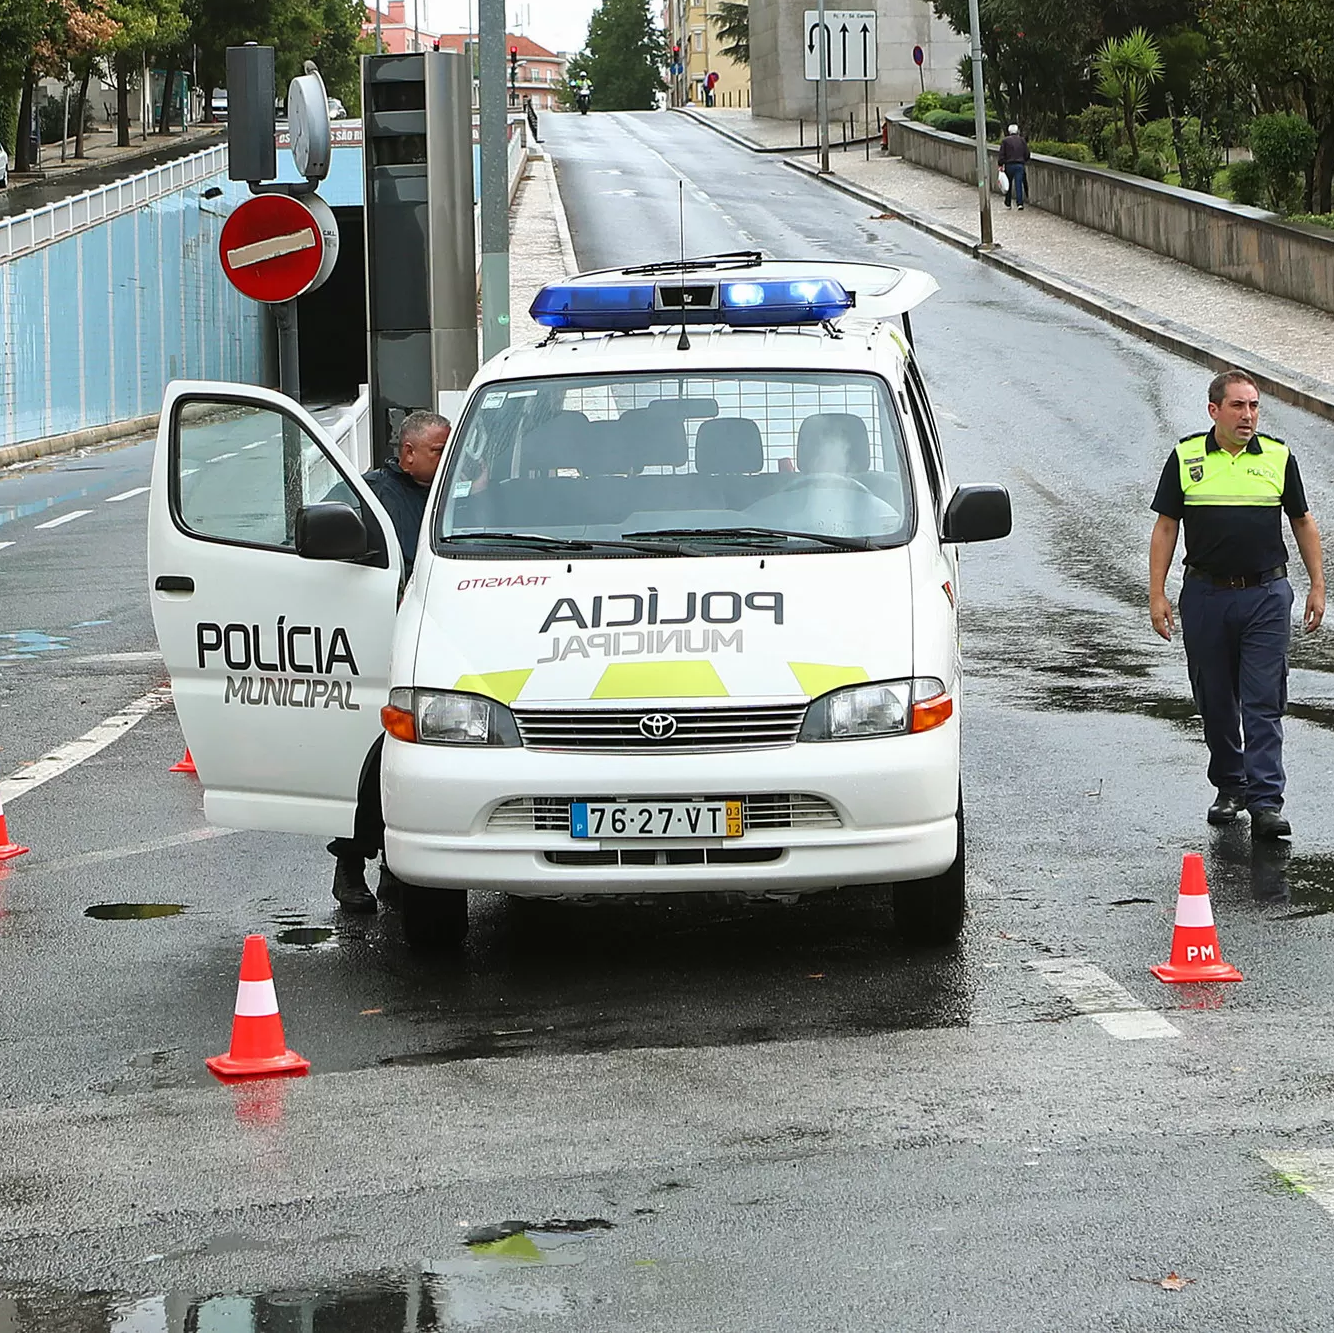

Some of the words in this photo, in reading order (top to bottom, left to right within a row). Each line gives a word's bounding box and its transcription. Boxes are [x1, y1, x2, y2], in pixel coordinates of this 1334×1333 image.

[196, 615, 360, 677] POLÍCIA
[224, 675, 361, 711] MUNICIPAL
[726, 807, 741, 817] 03
[576, 823, 583, 832] P
[728, 824, 741, 834] 12
[1186, 944, 1215, 962] PM
